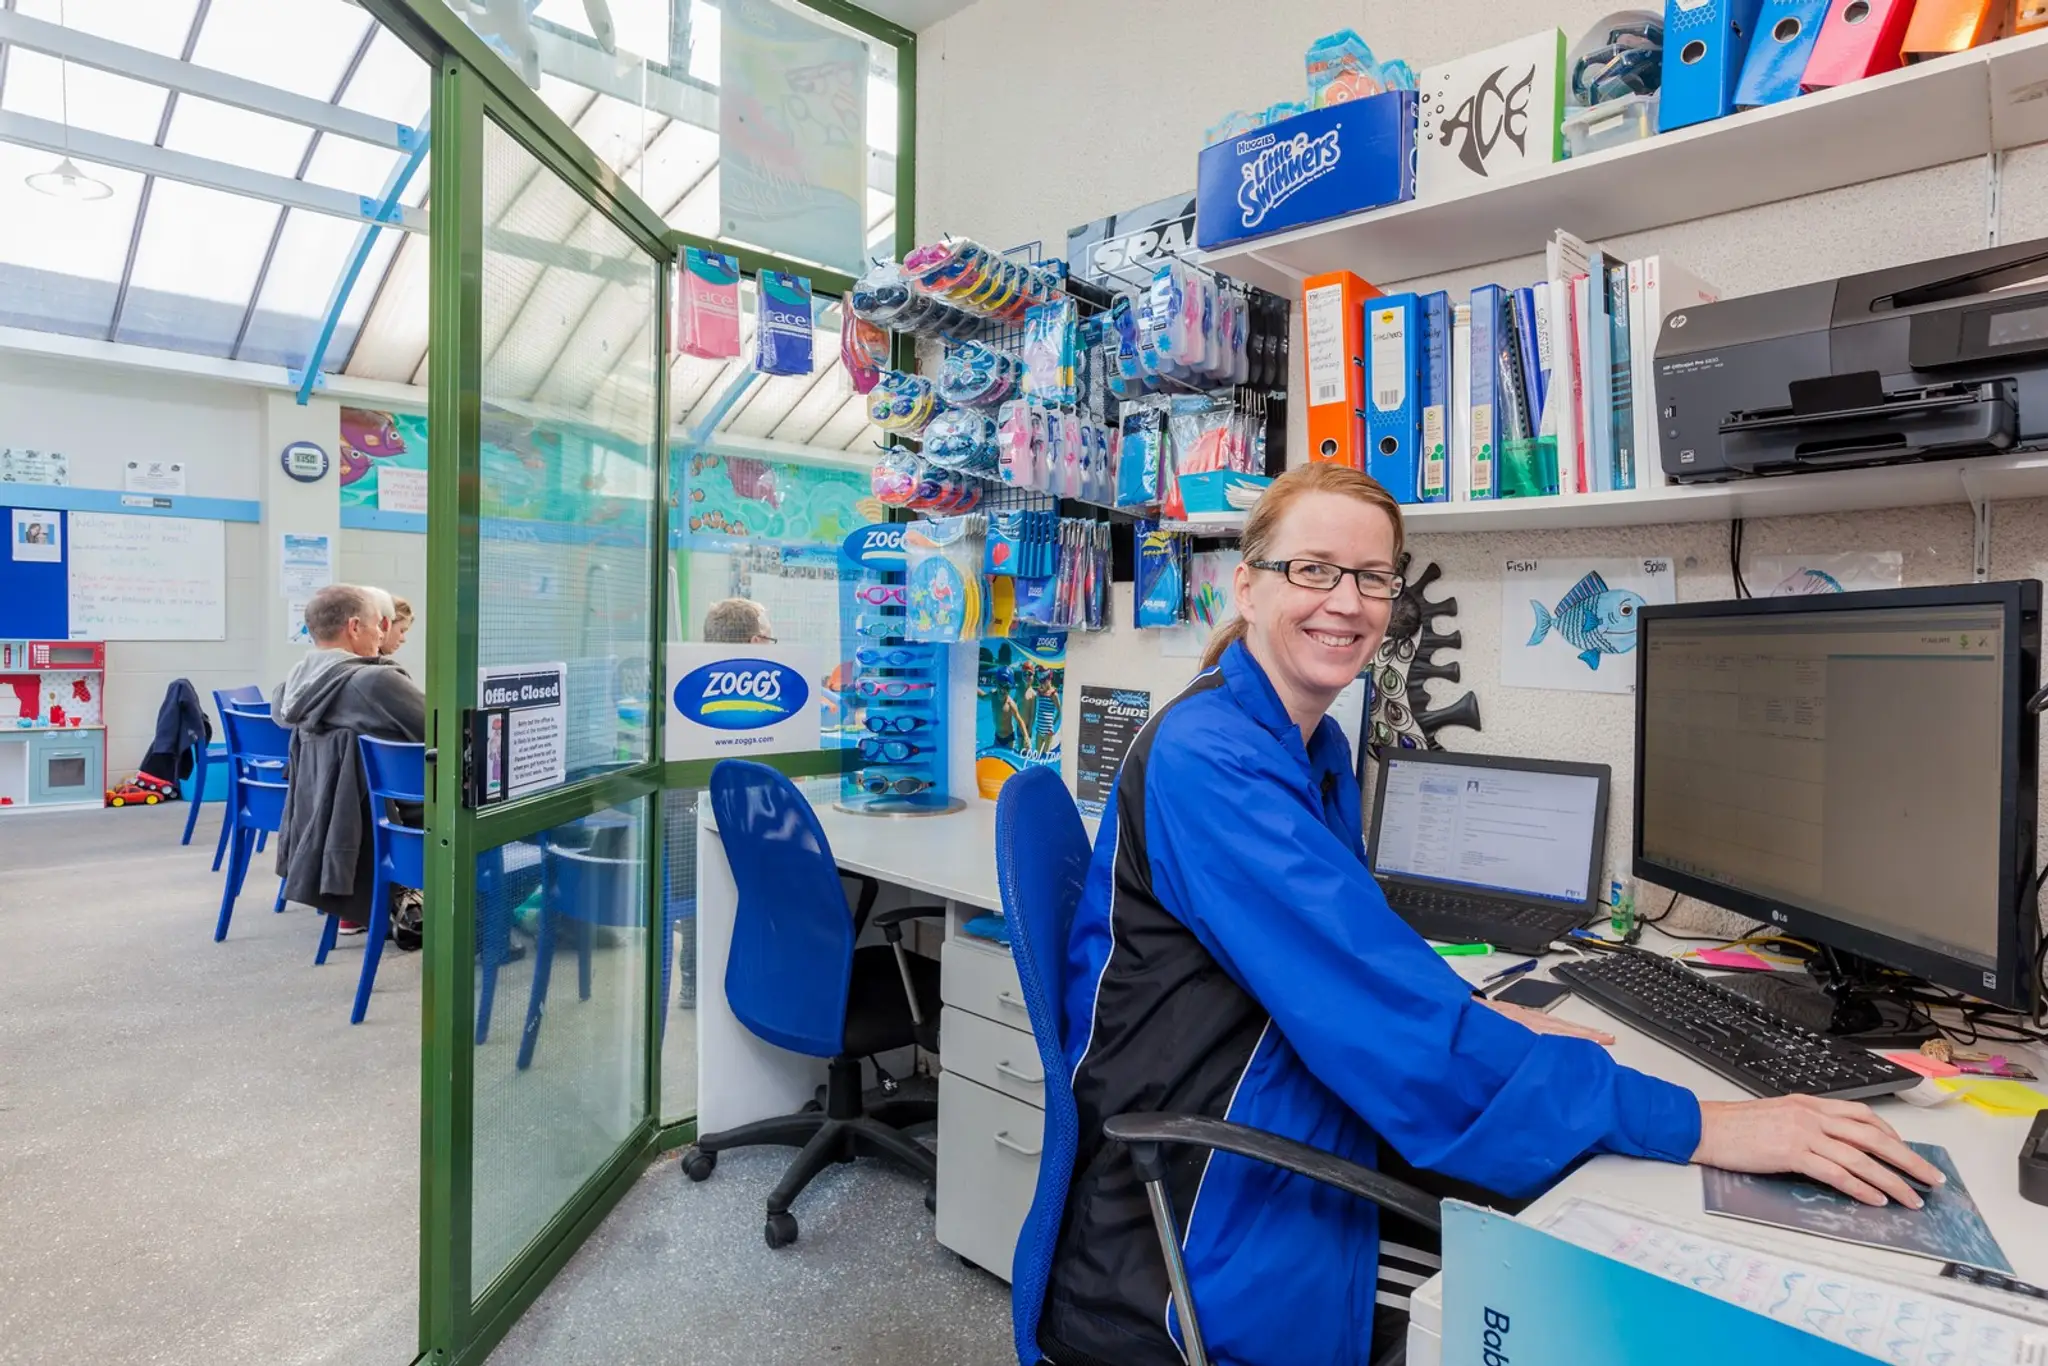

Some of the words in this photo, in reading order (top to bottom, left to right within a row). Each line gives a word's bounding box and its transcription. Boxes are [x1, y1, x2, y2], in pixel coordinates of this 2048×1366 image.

[1238, 134, 1275, 155] HUGGIES
[1253, 142, 1293, 184] Little
[699, 291, 734, 306] ace
[774, 311, 806, 326] ace
[863, 531, 906, 549] ZOG
[1506, 560, 1538, 572] Fish!
[1037, 637, 1057, 648] ZOGGS
[702, 669, 782, 701] ZOGGS
[485, 686, 519, 705] Office
[521, 682, 559, 700] Closed
[1081, 695, 1119, 706] Goggle
[1107, 706, 1149, 718] GUIDE
[714, 734, 774, 747] www.zoggs.com
